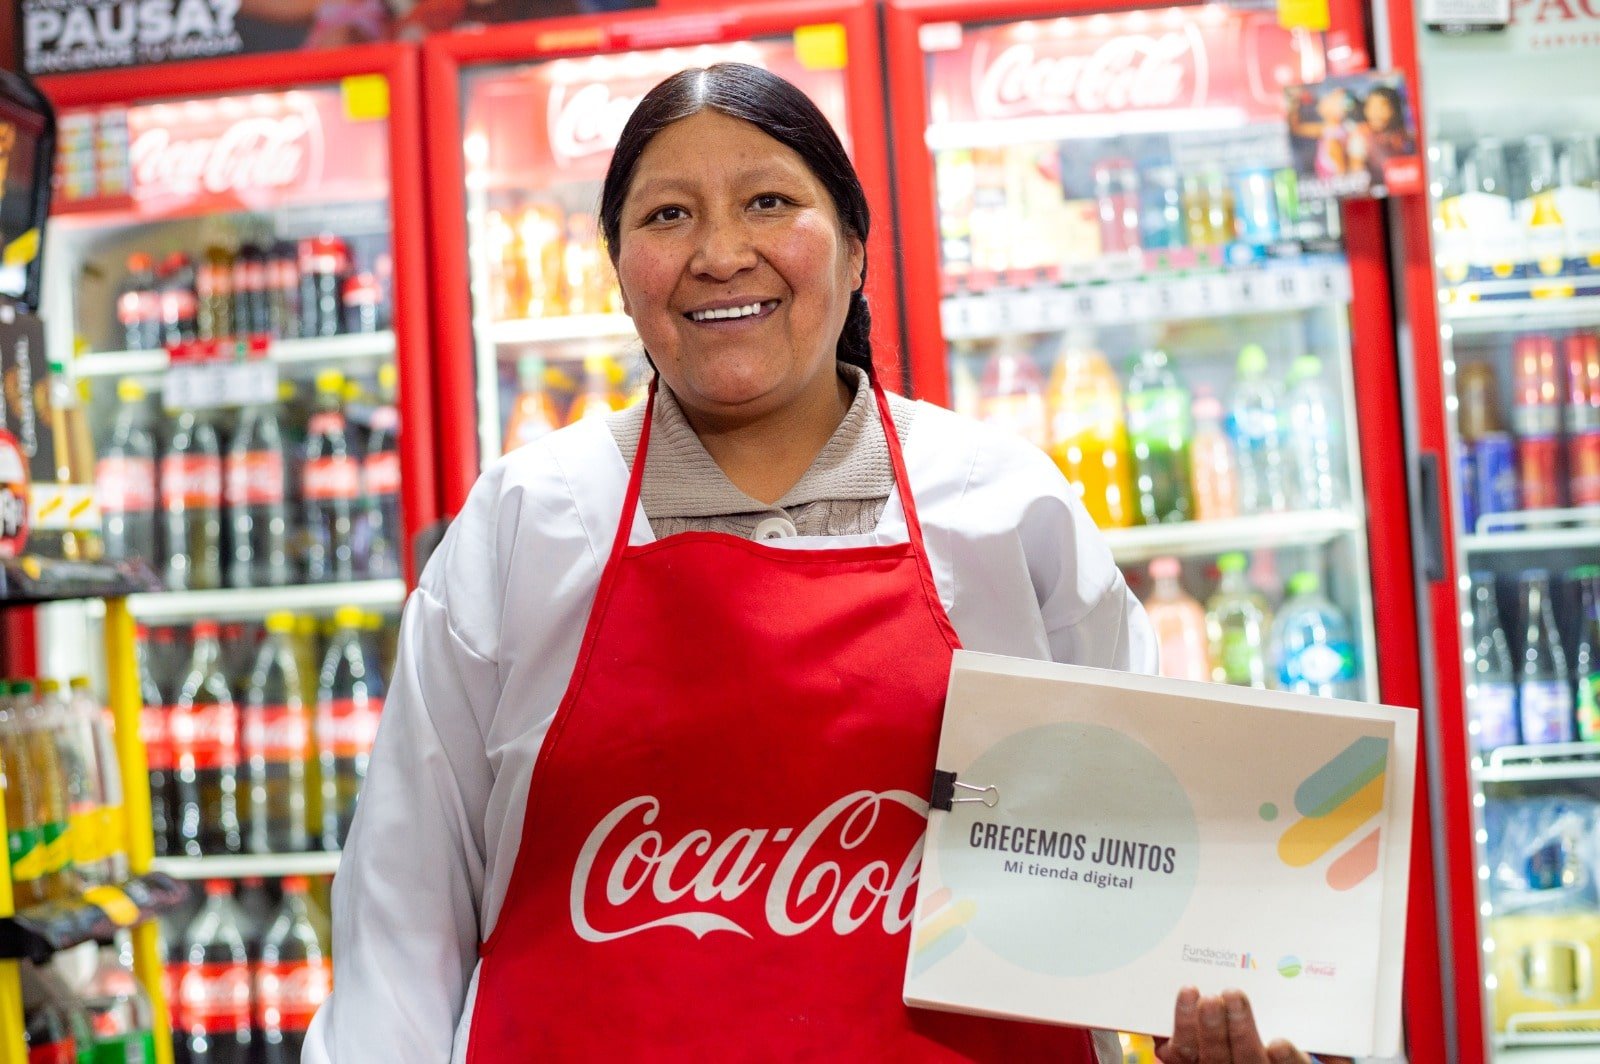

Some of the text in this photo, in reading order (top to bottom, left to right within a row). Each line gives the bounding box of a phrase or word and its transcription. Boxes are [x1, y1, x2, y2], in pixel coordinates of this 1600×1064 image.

[24, 0, 242, 53] PAUSA?
[570, 789, 932, 943] Coca-Col
[969, 821, 1176, 874] CRECEMOS JUNTOS
[1004, 860, 1133, 889] Mi tienda digital
